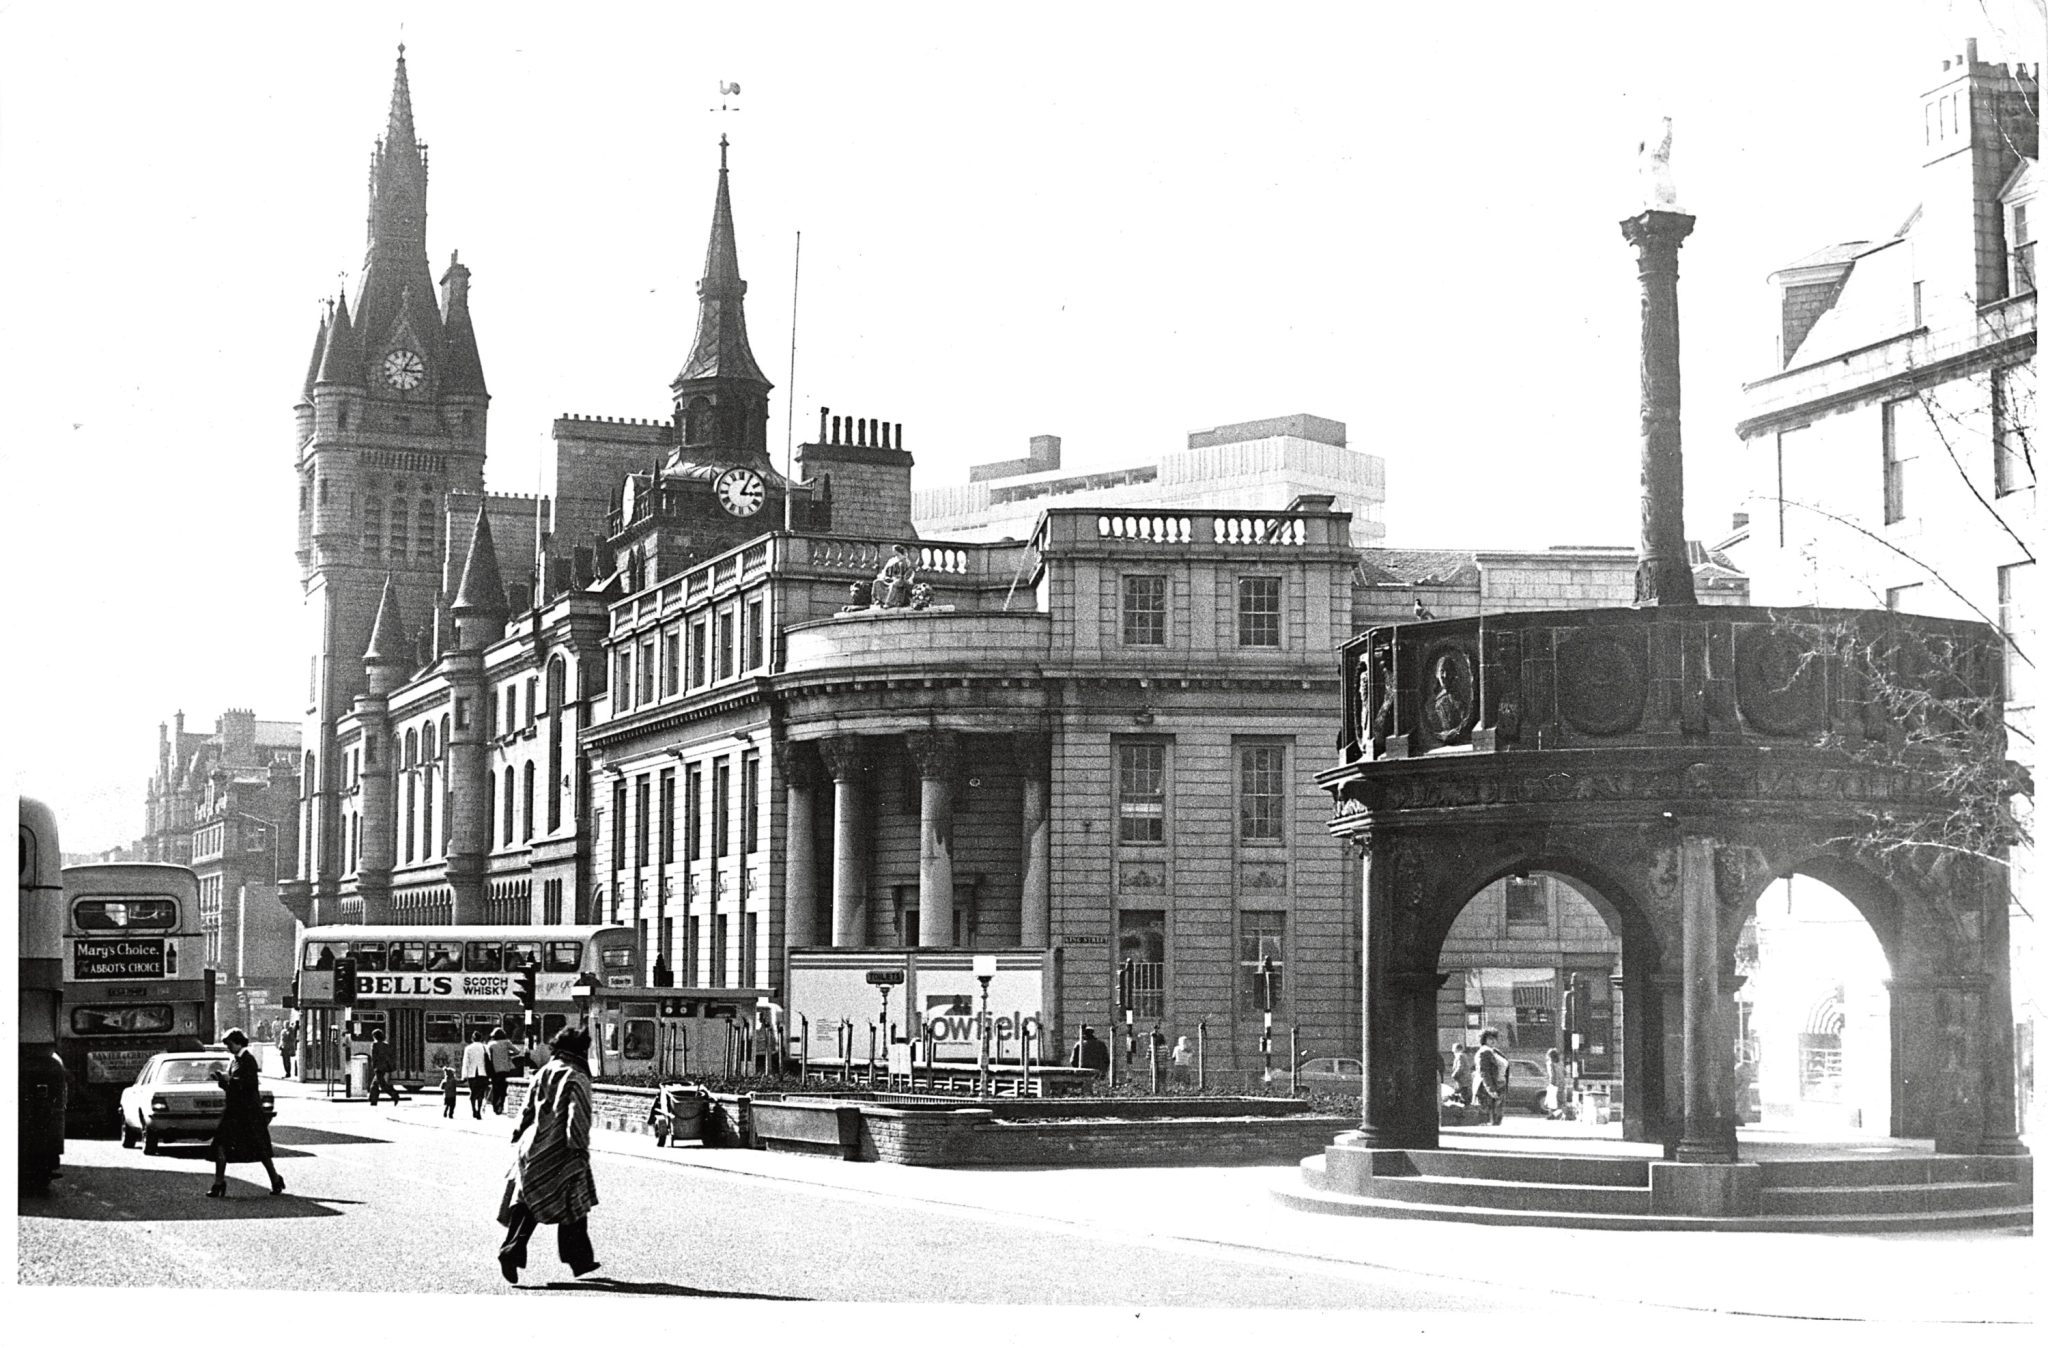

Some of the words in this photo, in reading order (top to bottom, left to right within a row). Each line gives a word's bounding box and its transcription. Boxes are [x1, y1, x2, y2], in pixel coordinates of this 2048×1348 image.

[77, 943, 115, 959] Mary's
[116, 943, 160, 955] Choice.
[90, 963, 126, 973] ABBOT'S
[128, 962, 160, 973] CHOICE
[356, 976, 452, 995] BELL'S
[464, 976, 509, 986] SCOTCH
[463, 986, 509, 995] WHISKY
